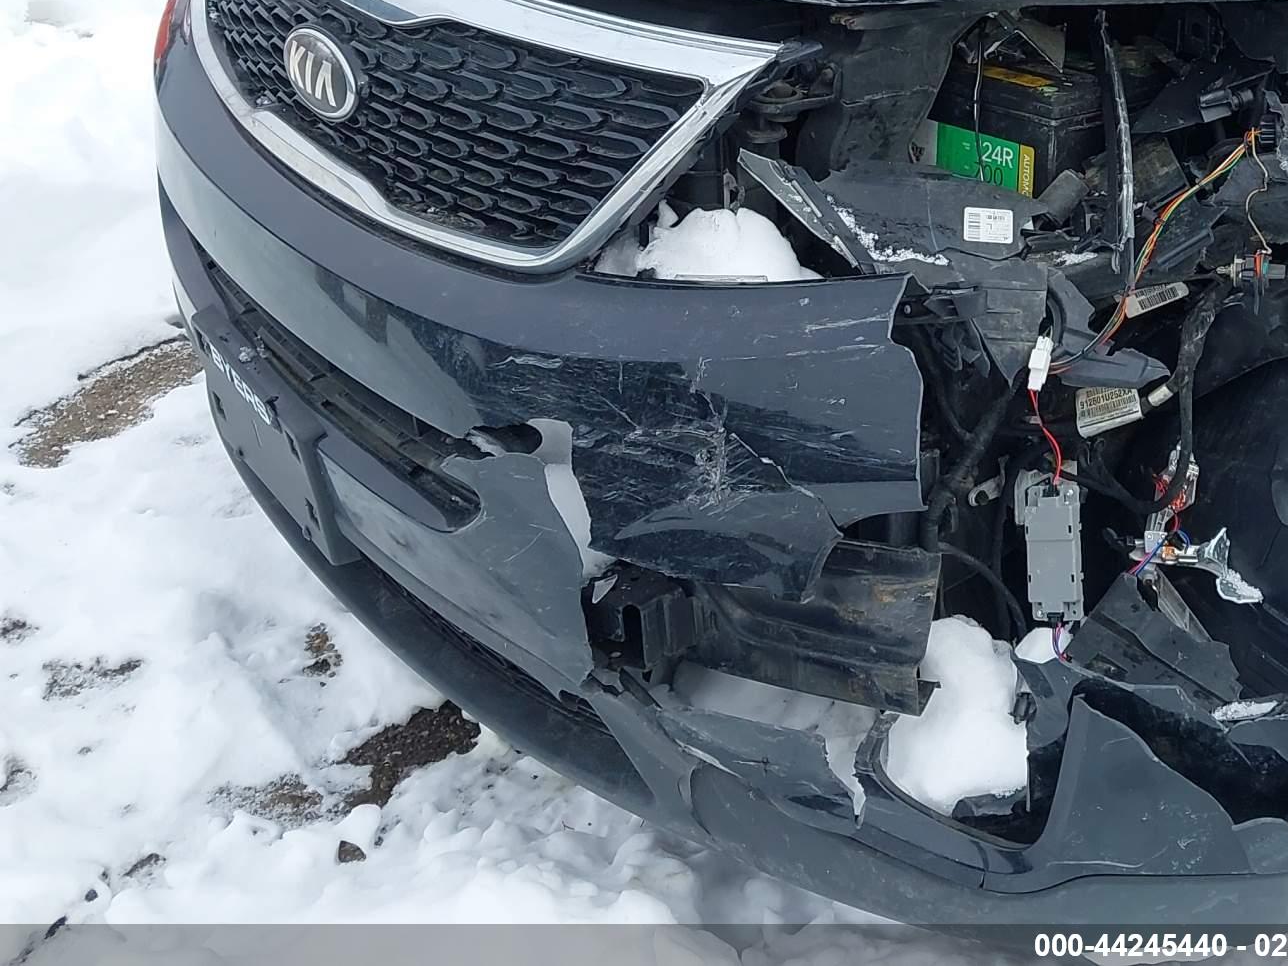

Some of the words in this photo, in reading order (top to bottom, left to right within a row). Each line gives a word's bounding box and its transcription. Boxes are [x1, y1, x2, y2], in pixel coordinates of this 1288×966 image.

[289, 40, 337, 107] KIA
[981, 141, 1014, 169] 24R
[209, 342, 273, 426] BYERS
